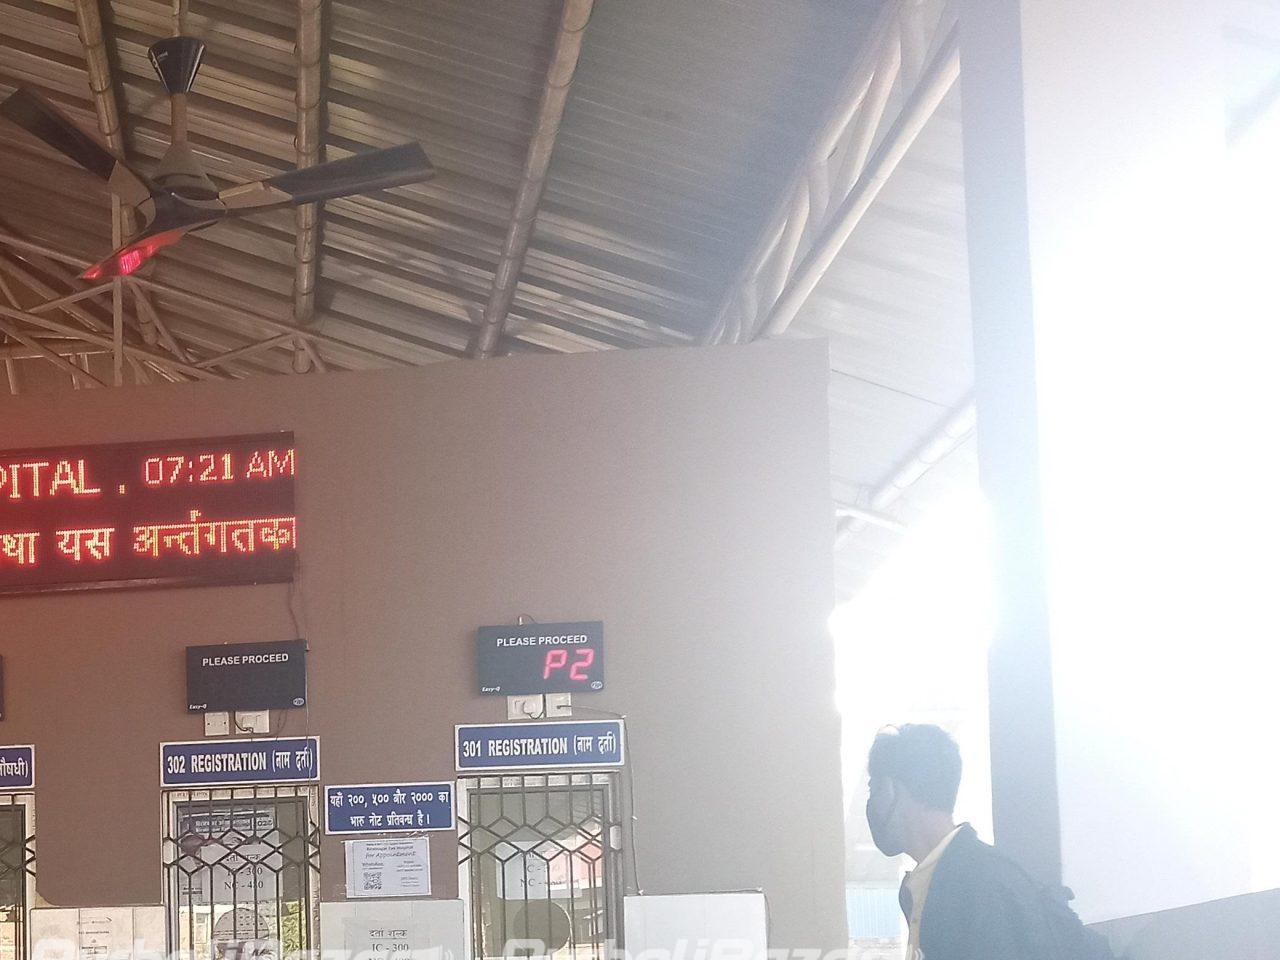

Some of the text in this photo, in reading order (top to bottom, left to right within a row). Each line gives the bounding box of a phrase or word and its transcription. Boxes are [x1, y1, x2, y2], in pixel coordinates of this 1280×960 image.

[145, 452, 234, 485] 07:21
[247, 449, 295, 478] AM
[56, 527, 115, 560] यस
[496, 634, 588, 647] PLEASE PROCEED
[202, 653, 289, 667] PLEASE PROCEED
[543, 648, 595, 681] P2
[463, 740, 482, 757] 301
[488, 737, 568, 757] REGISTRATION
[167, 755, 186, 774] 302
[191, 752, 267, 773] REGISTRATION
[372, 793, 389, 806] ५००
[411, 792, 433, 804] २०००
[438, 791, 449, 803] का
[372, 943, 383, 952] IC
[392, 943, 409, 952] 300
